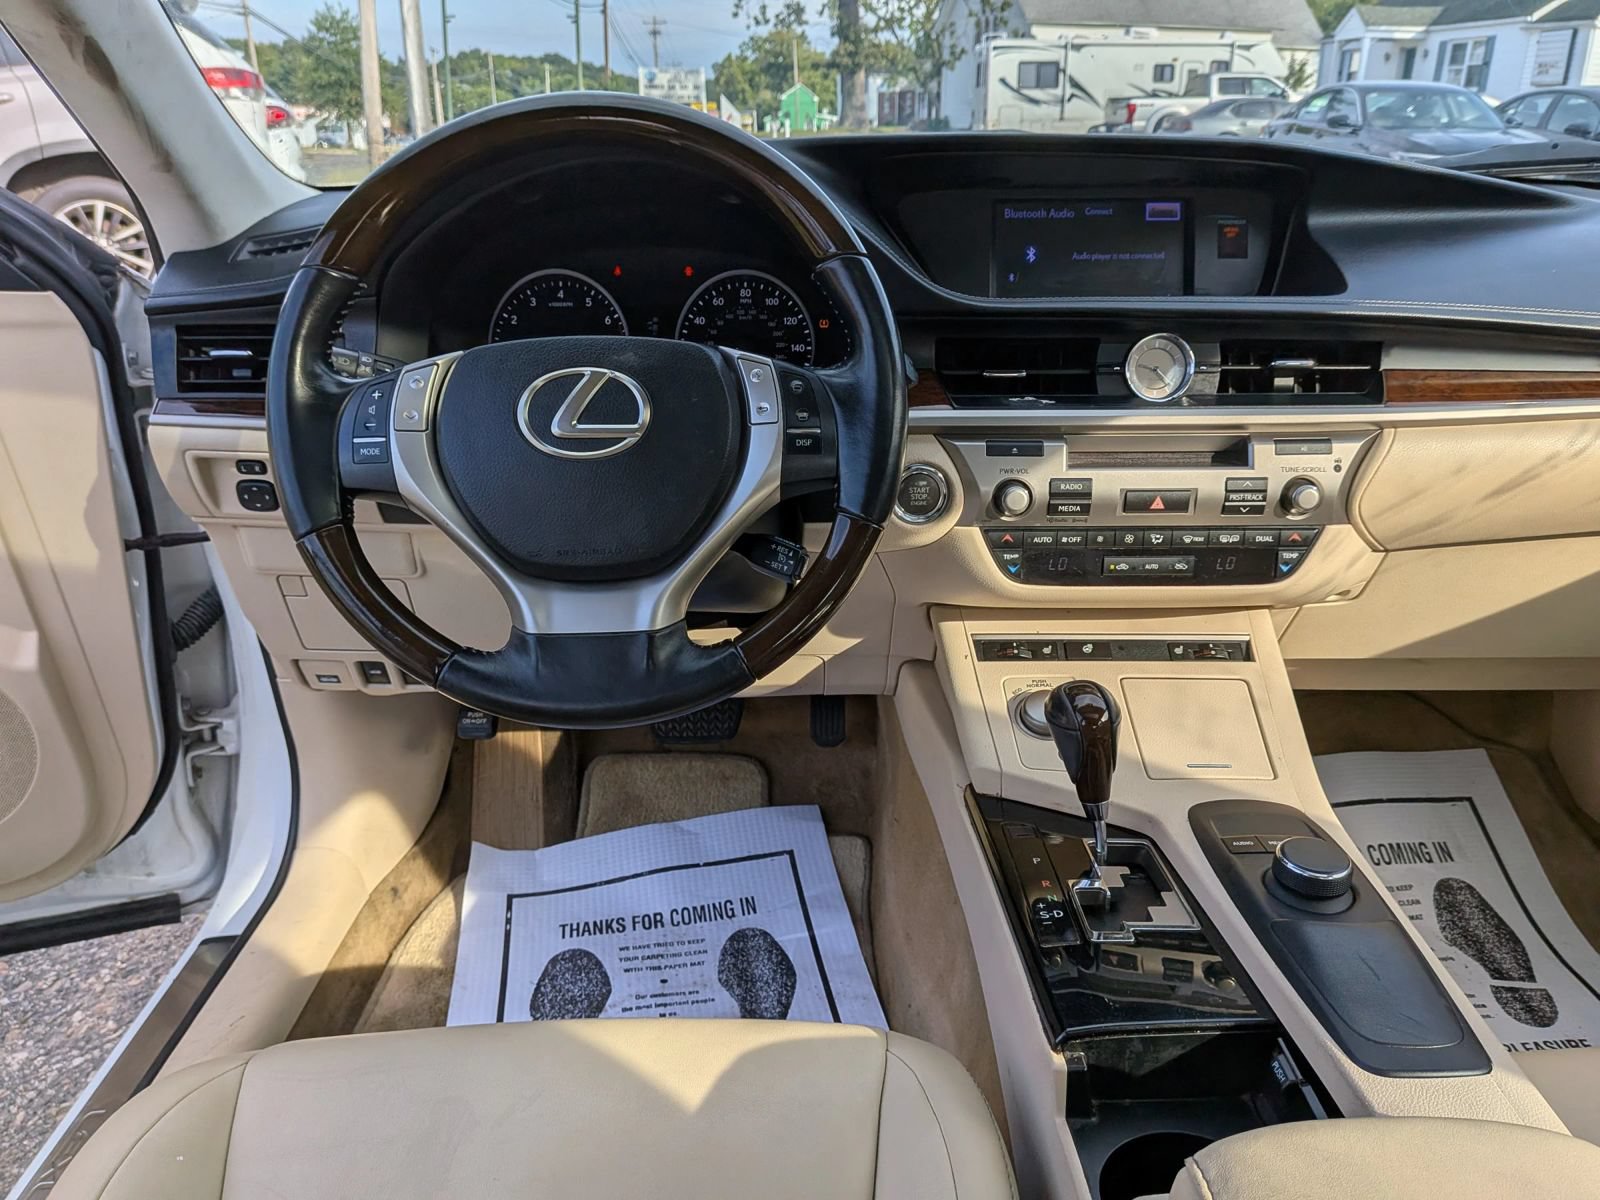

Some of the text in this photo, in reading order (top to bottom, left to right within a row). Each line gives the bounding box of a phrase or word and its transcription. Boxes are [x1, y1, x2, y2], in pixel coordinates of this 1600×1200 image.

[1004, 207, 1075, 218] Bluetooth Audio
[1085, 207, 1113, 216] Connect
[1072, 251, 1090, 261] Audio
[1091, 251, 1112, 262] player
[1119, 251, 1130, 260] not
[1131, 250, 1165, 260] connected
[557, 289, 564, 299] 4
[740, 288, 752, 297] 80
[529, 297, 537, 307] 3
[585, 297, 592, 307] 5
[712, 297, 724, 306] 60
[765, 297, 779, 306] 100
[510, 315, 518, 325] 2
[604, 315, 612, 325] 6
[693, 316, 706, 325] 40
[783, 316, 798, 325] 120
[791, 344, 805, 352] 140
[796, 438, 812, 446] DISP
[360, 448, 381, 456] MODE
[908, 486, 930, 494] START
[1366, 840, 1455, 866] COMING IN
[1041, 880, 1052, 888] R
[1396, 884, 1414, 892] KEEP
[1047, 894, 1058, 902] N
[559, 895, 758, 940] THANKS FOR COMING IN
[632, 943, 651, 951] HAVE
[653, 941, 675, 949] TRIED
[641, 951, 683, 961] CARPETING
[684, 949, 708, 957] CLEAN
[649, 991, 686, 999] customers
[654, 1000, 689, 1009] important
[691, 997, 716, 1006] people
[1271, 1060, 1286, 1082] PUSH
